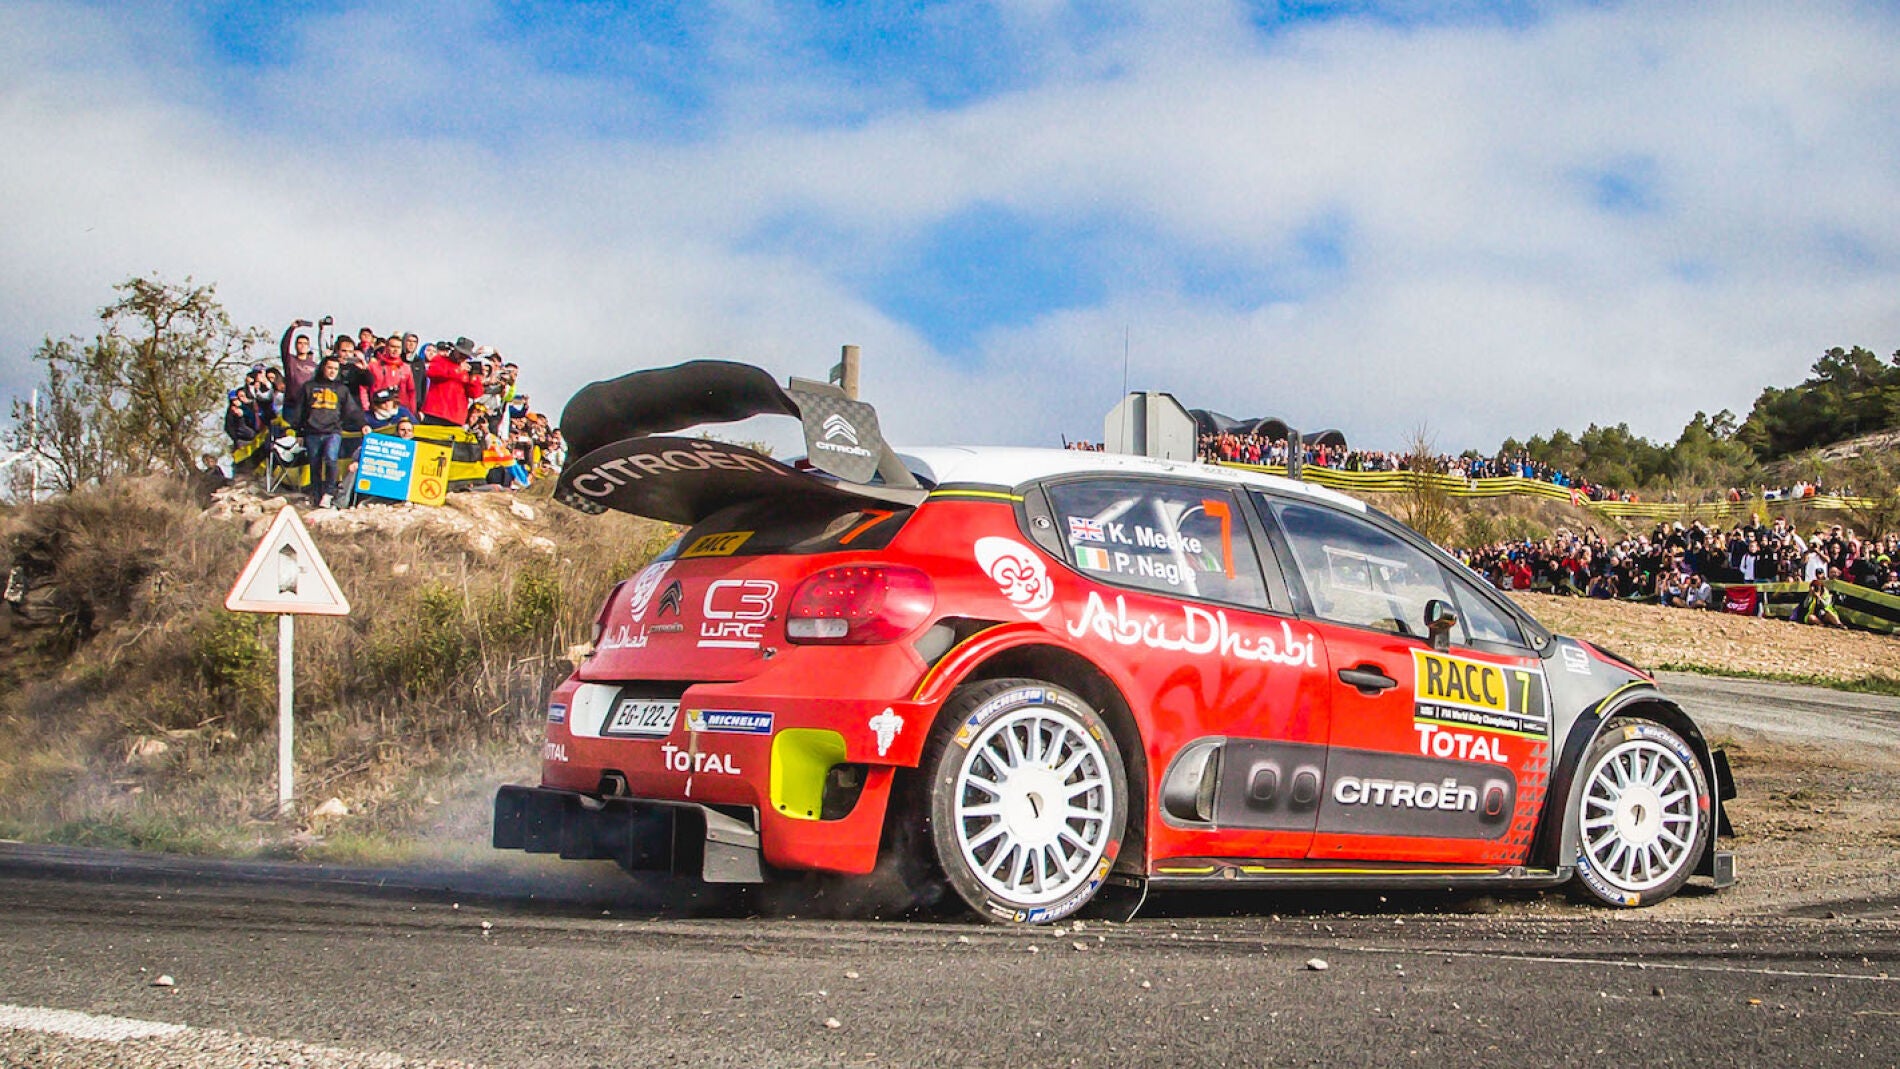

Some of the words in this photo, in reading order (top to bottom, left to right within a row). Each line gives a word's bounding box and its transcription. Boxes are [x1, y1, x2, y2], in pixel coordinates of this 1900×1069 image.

[697, 535, 739, 552] RACC
[839, 508, 894, 545] 7
[1108, 522, 1133, 545] K.
[1134, 525, 1202, 554] Meeke
[1202, 499, 1236, 580] 7
[1114, 551, 1134, 575] P.
[1137, 555, 1197, 585] Nagle
[703, 579, 779, 620] C3
[700, 622, 766, 638] WRC
[1426, 656, 1497, 705] RACC
[1515, 671, 1530, 715] 7
[708, 714, 771, 728] MICHELIN
[661, 743, 741, 775] TOTAL
[1413, 723, 1508, 763] TOTAL
[1334, 777, 1478, 811] CITROËN
